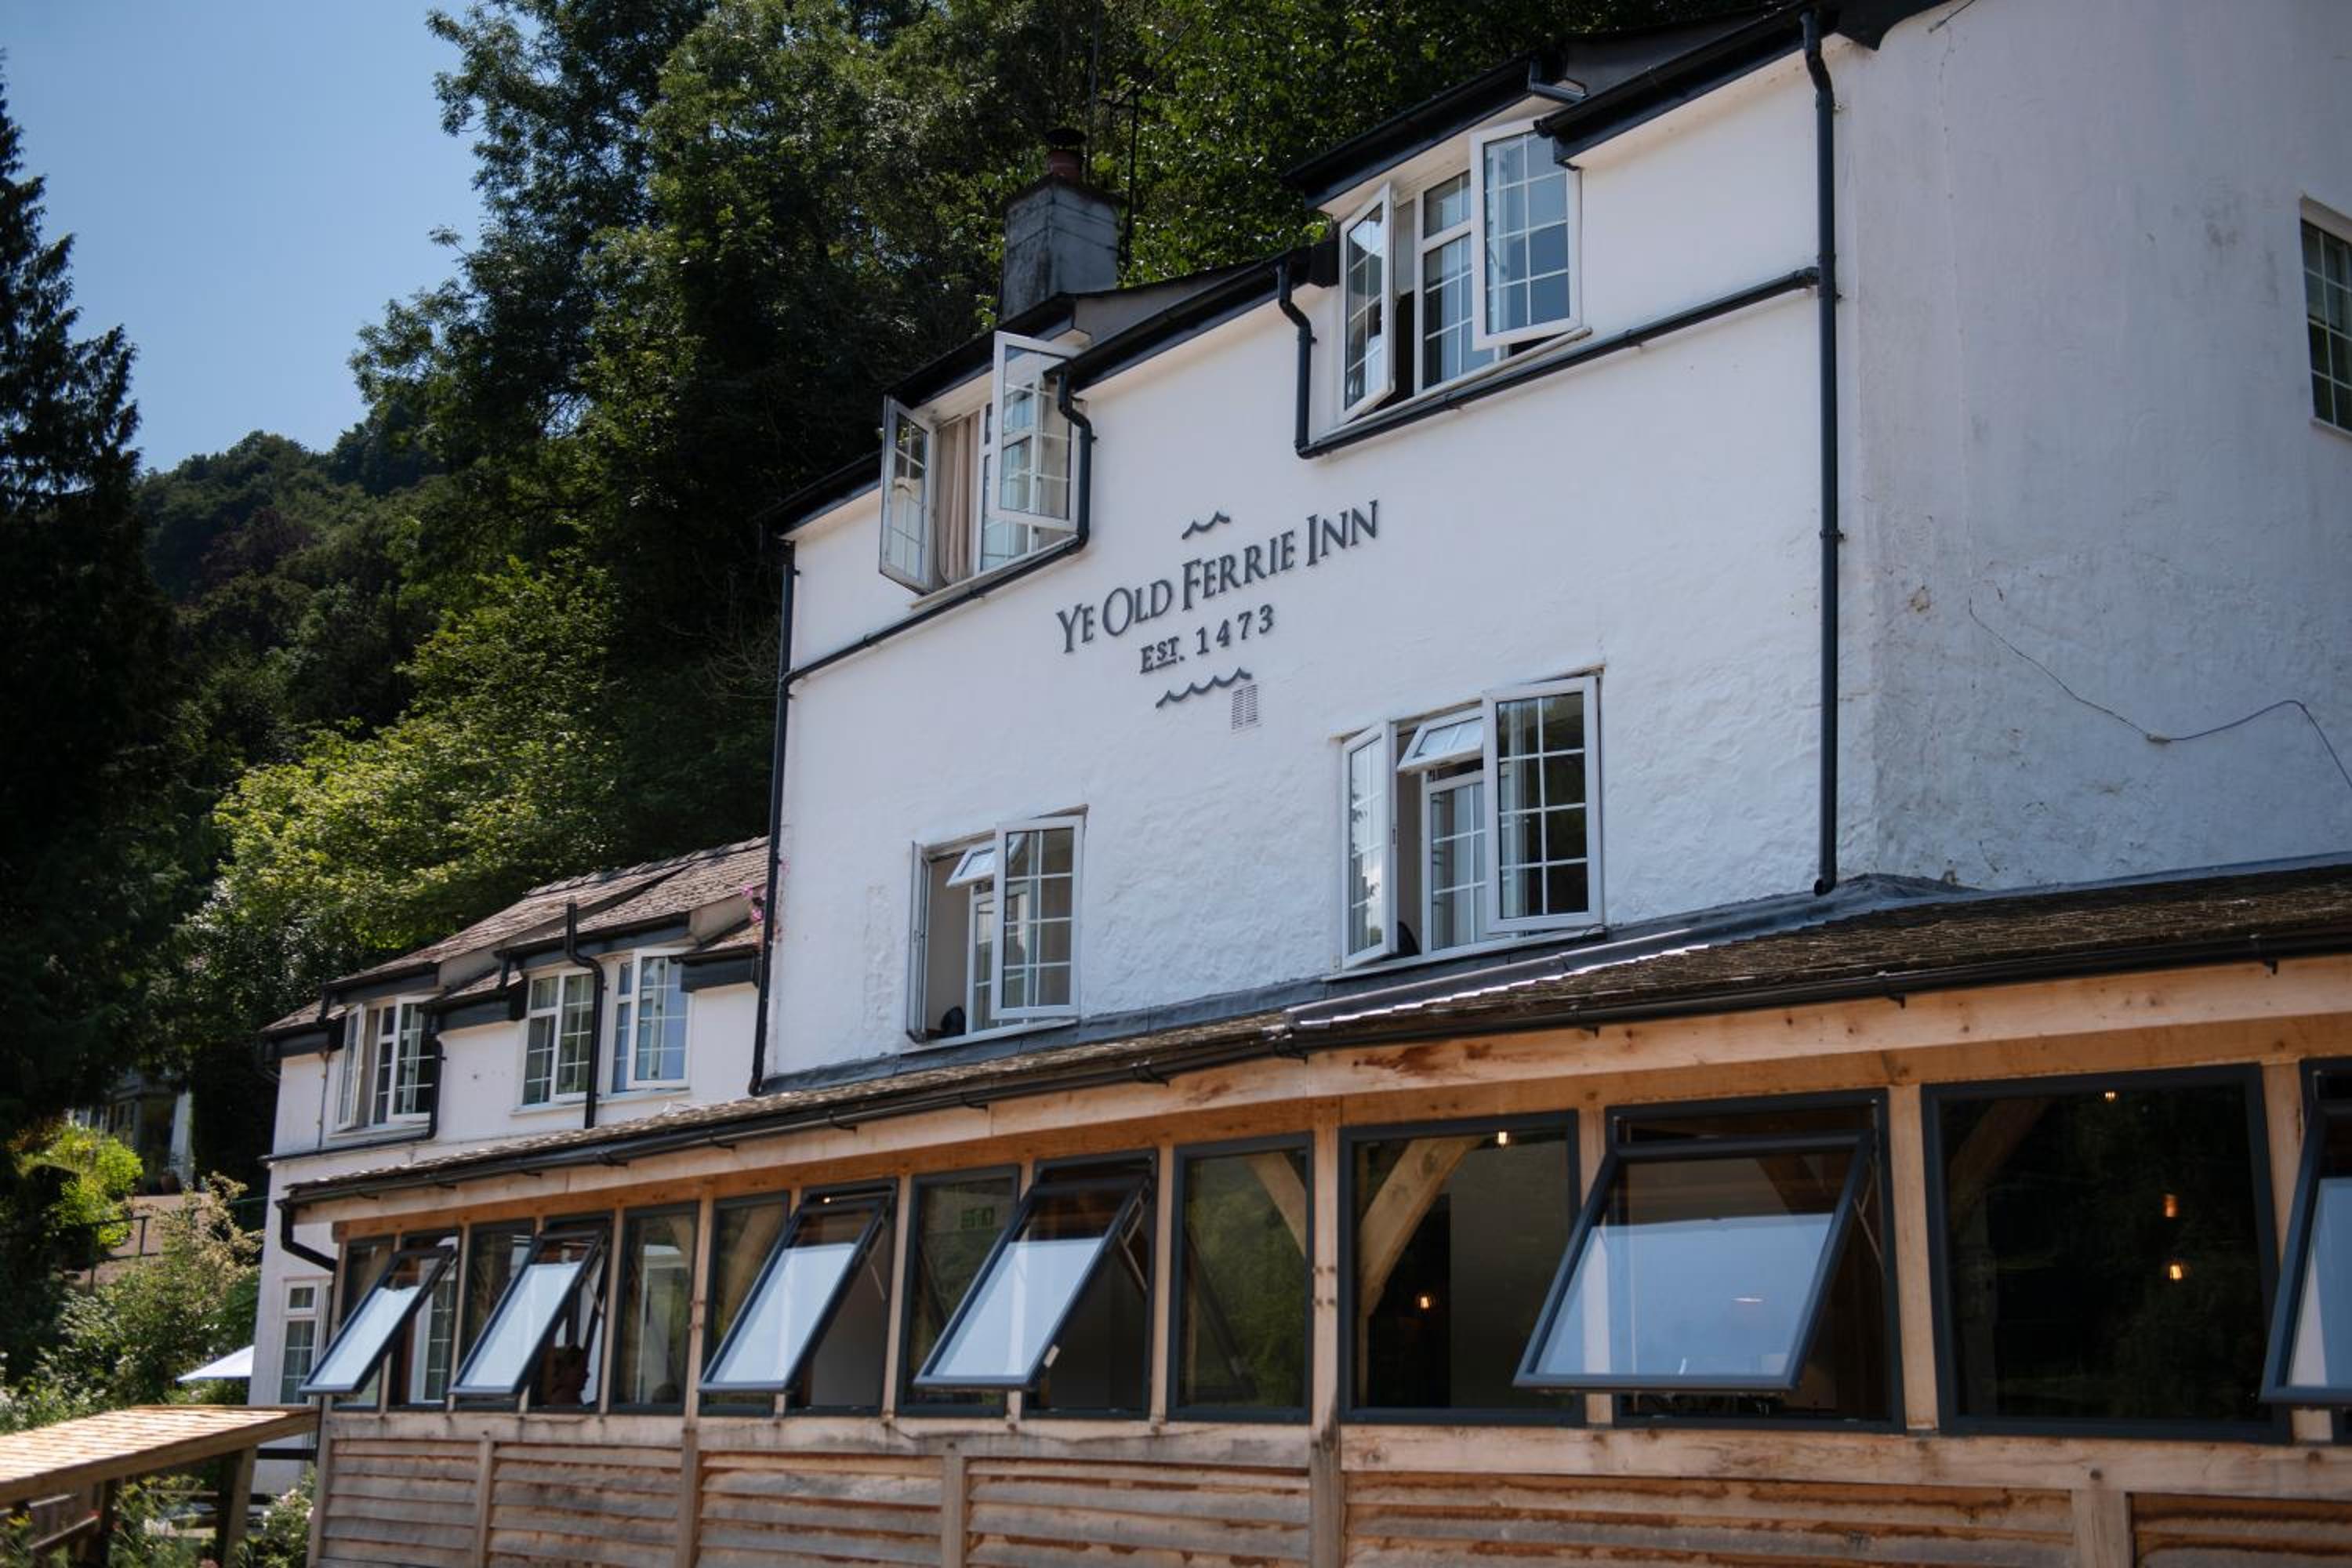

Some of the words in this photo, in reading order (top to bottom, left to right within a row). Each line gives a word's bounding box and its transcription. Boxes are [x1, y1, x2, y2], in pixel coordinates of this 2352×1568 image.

[1056, 603, 1094, 653] YE
[1102, 579, 1173, 637] OLD
[1181, 530, 1295, 611] FERRIE
[1307, 499, 1379, 566] INN
[1196, 604, 1275, 655] 1473
